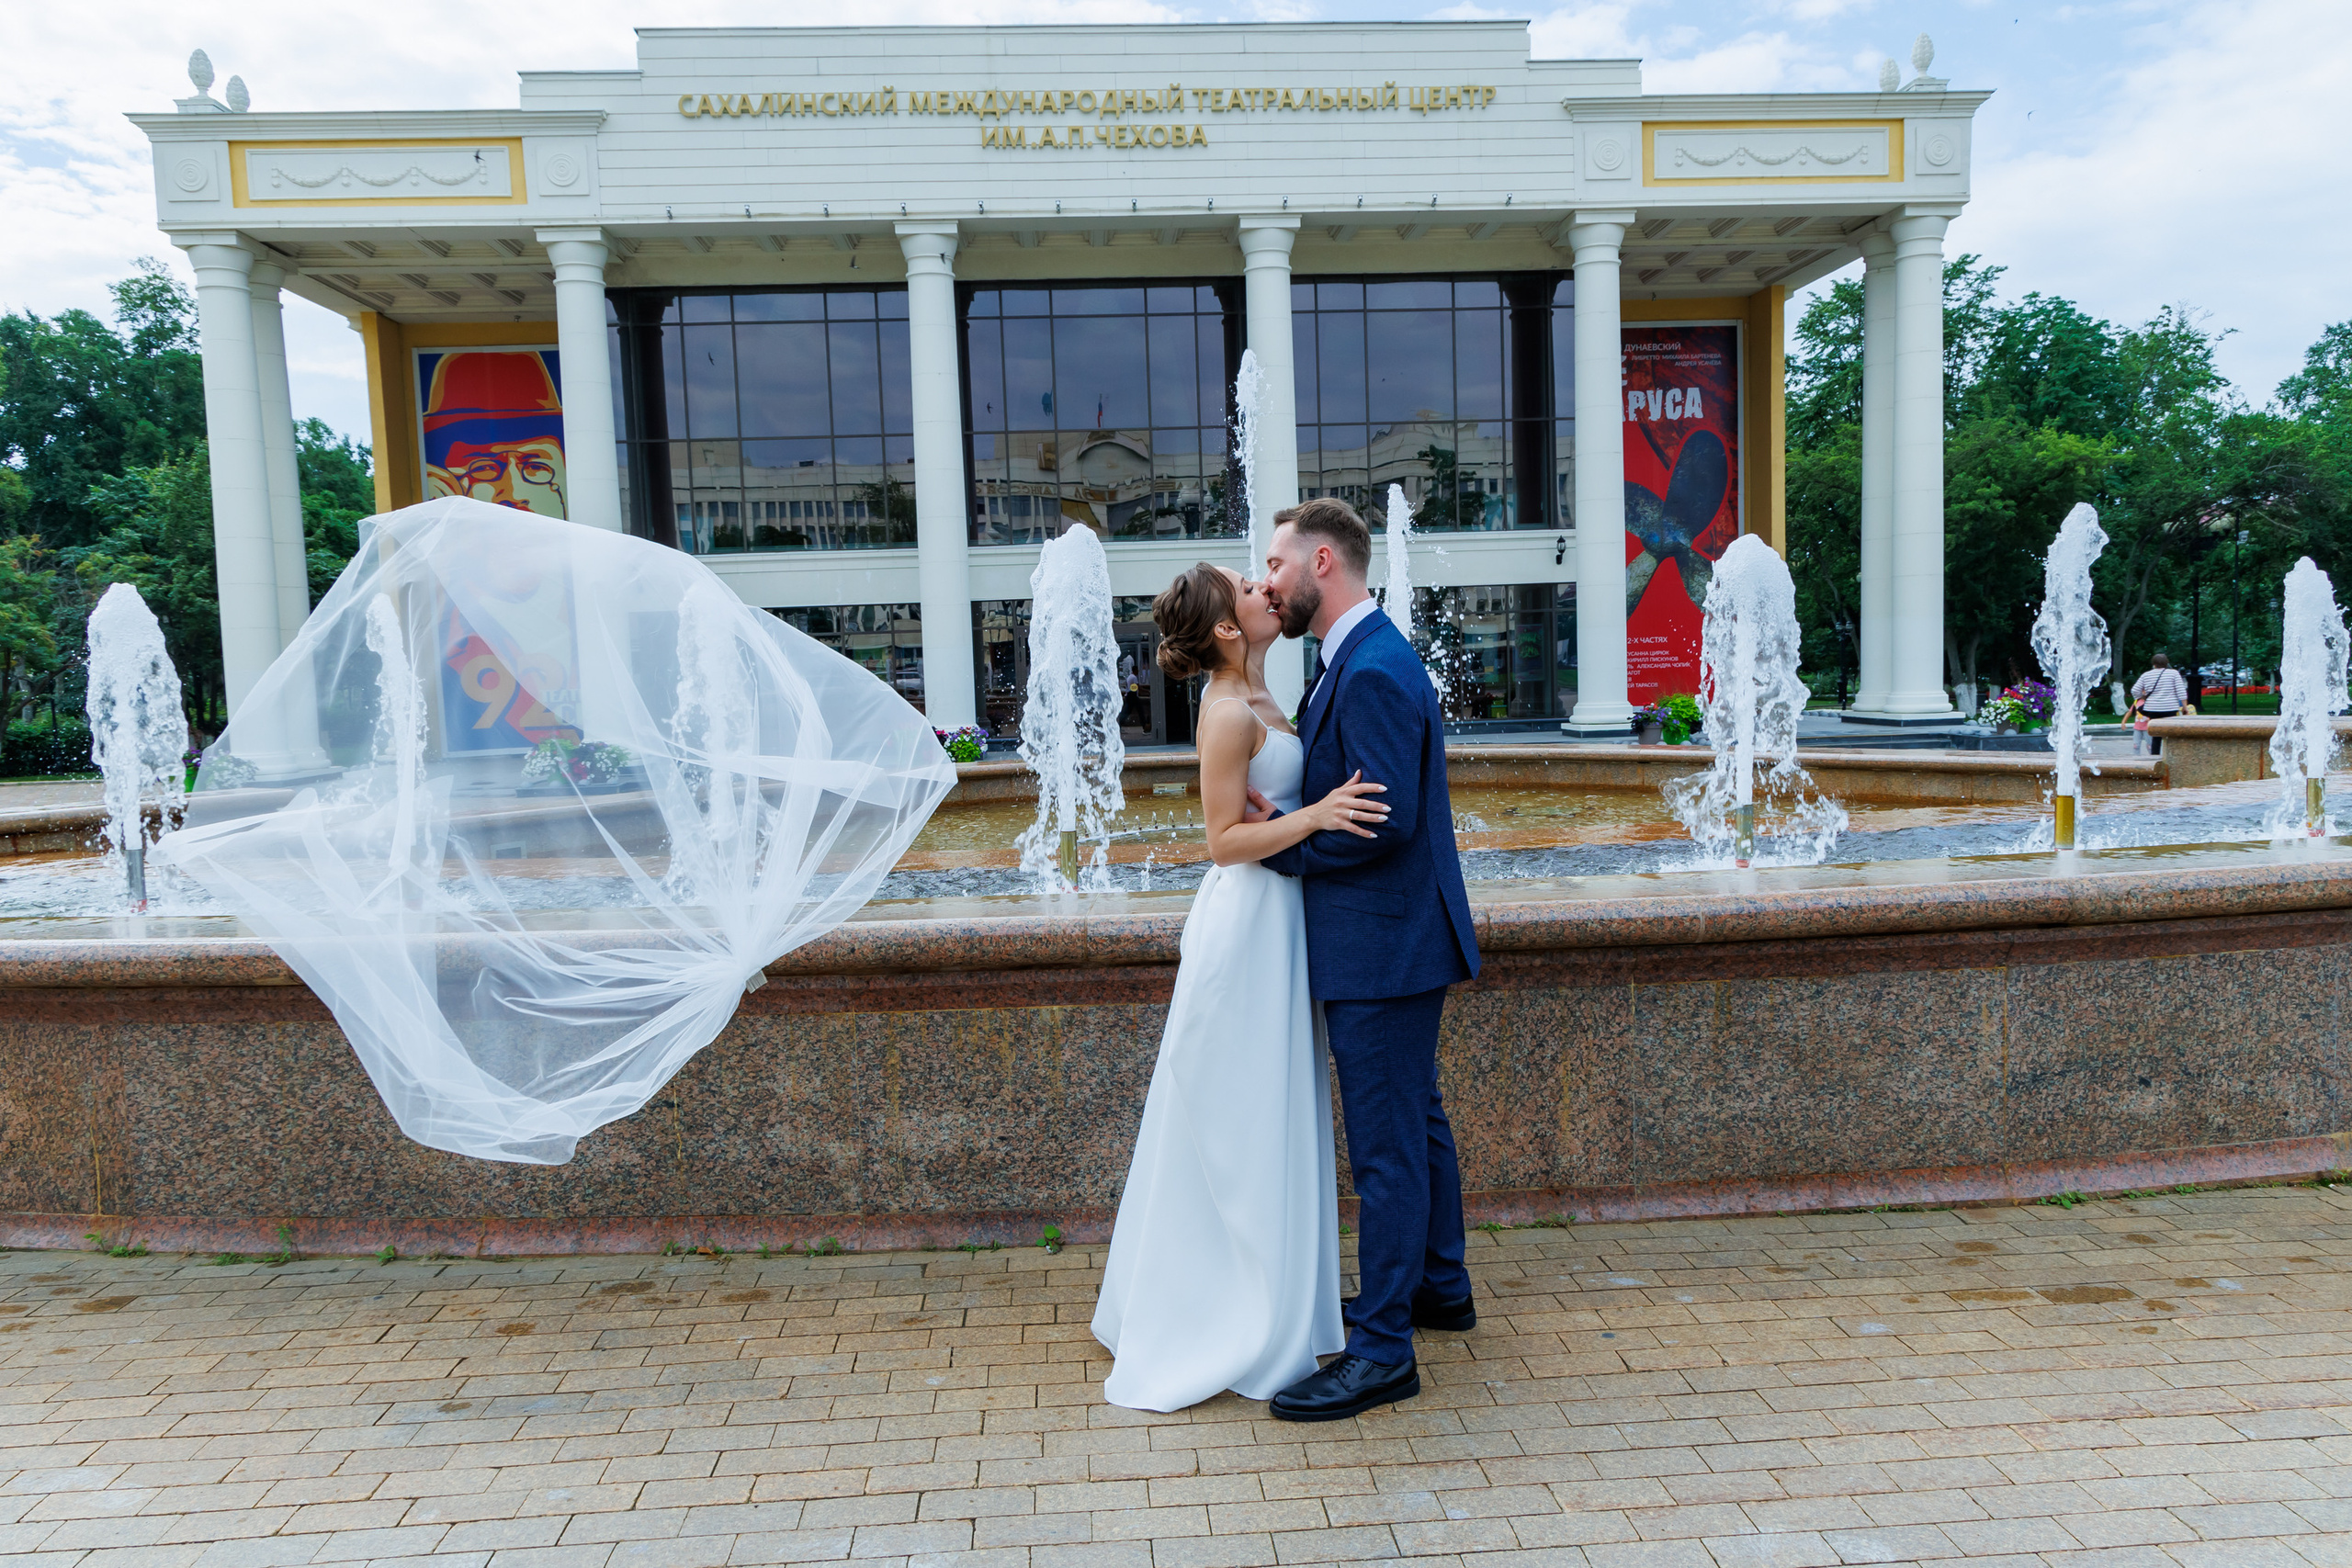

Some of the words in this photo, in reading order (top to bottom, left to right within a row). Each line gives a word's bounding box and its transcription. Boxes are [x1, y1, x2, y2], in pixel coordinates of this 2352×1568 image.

[678, 85, 898, 118] САХАЛИНСКИЙ
[909, 84, 1184, 120] МЕЖДУНАРОДНЫЙ
[1193, 81, 1399, 111] ТЕАТРАЛЬНЫЙ
[1409, 85, 1497, 116] ЦЕНТР
[1624, 342, 1681, 353] ДУНАЕВСКИЙ
[1622, 388, 1703, 423] РУСА
[539, 689, 581, 702] ТЕАТ
